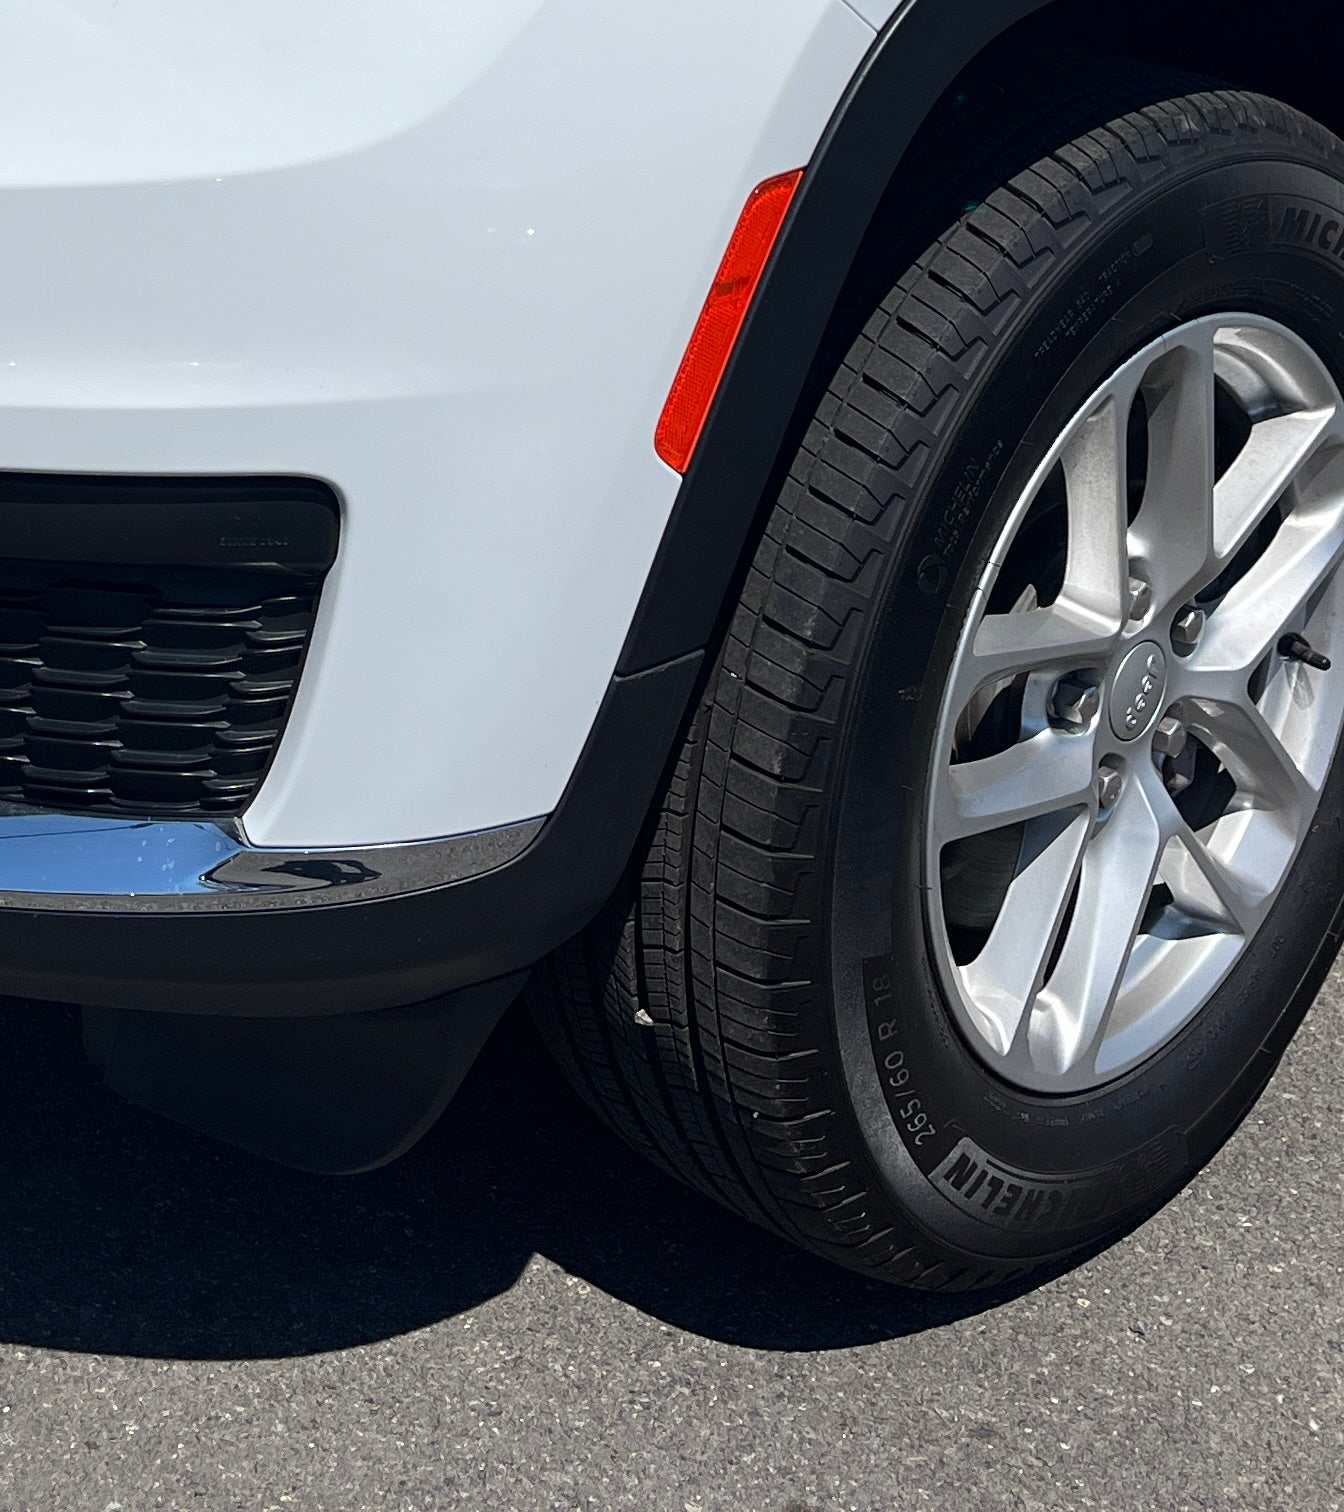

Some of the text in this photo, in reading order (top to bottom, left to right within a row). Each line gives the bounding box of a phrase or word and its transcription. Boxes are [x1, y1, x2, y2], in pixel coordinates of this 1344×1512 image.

[1125, 653, 1160, 731] Jeep
[871, 973, 937, 1147] 265/60 R 18
[942, 1152, 1110, 1226] ICHELIN
